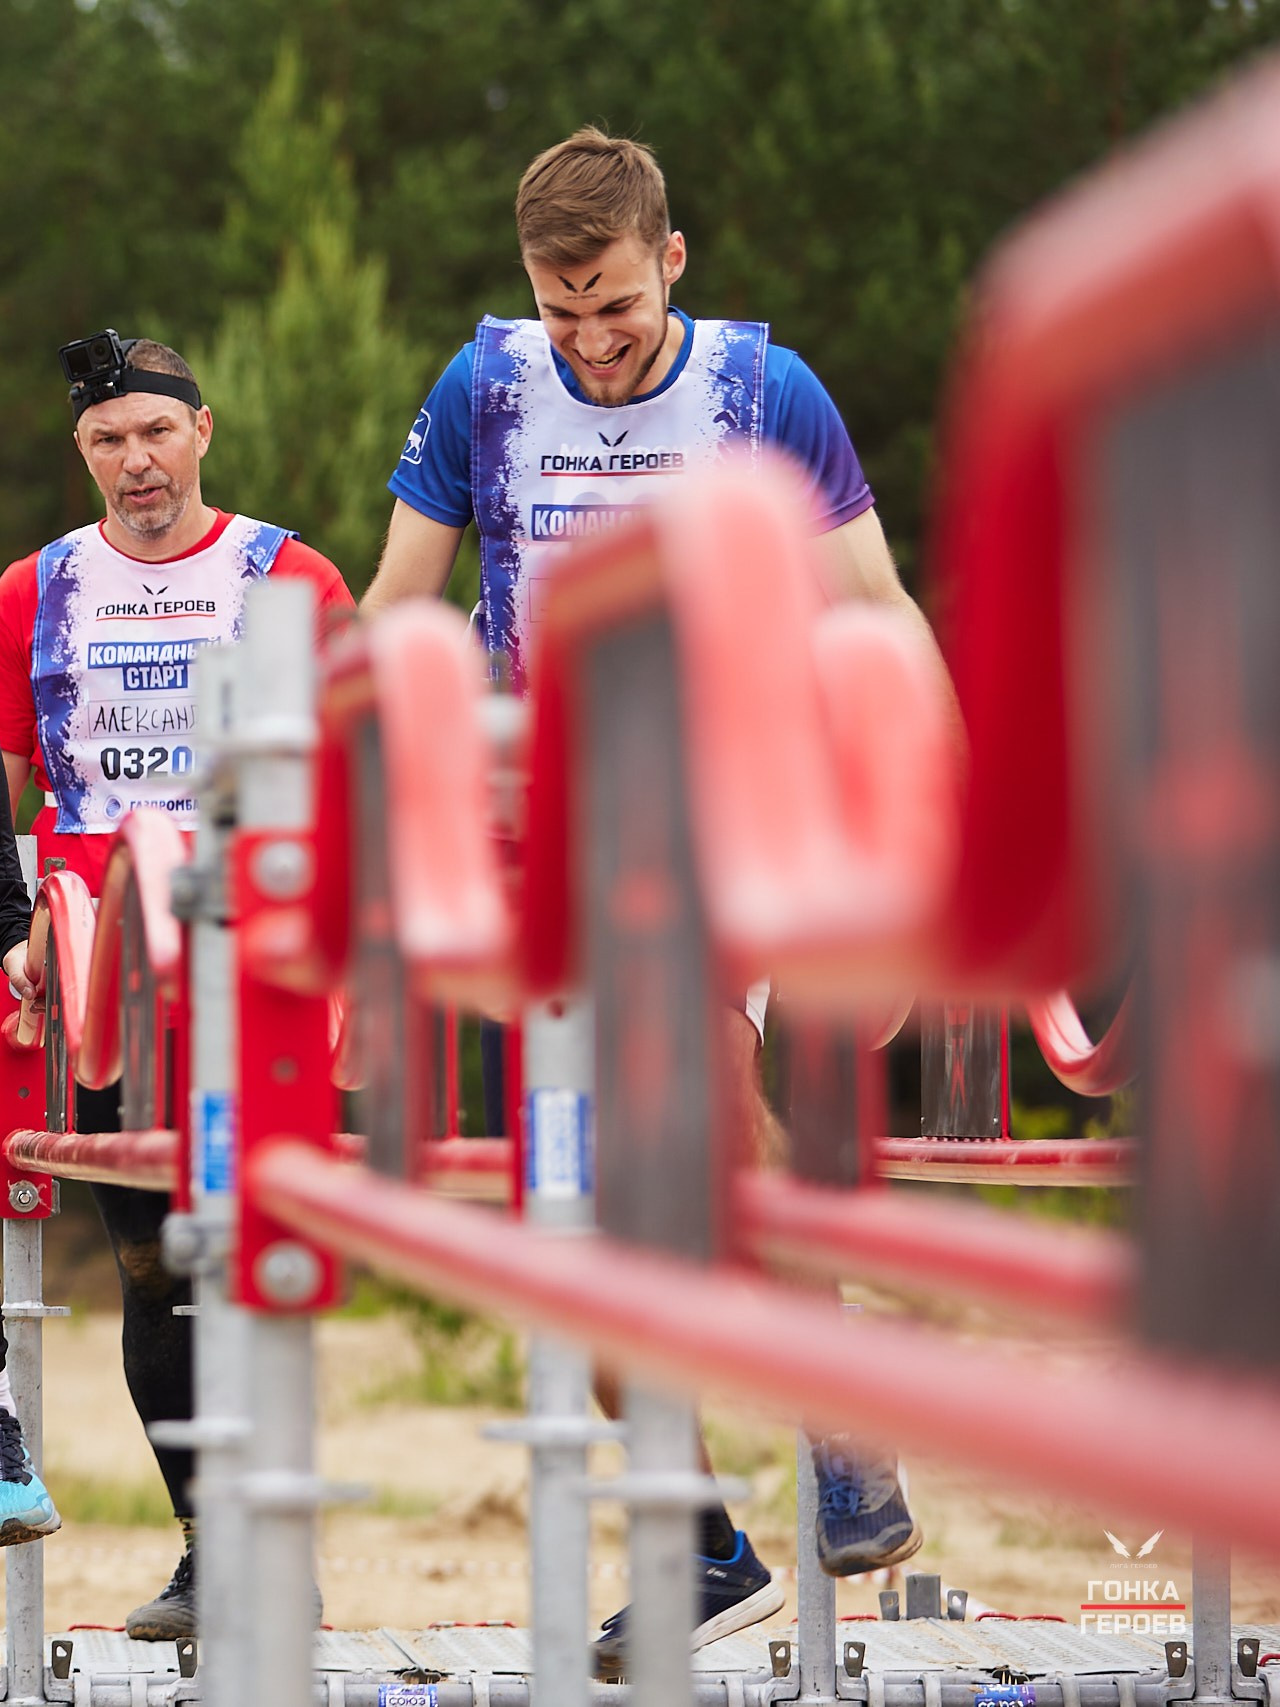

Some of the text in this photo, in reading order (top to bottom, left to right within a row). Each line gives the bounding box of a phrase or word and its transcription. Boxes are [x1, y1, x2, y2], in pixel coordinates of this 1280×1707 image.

[541, 453, 684, 471] ГОНКА ГЕРОЕВ
[96, 600, 216, 617] ГОНКА ГЕРОЕВ
[90, 638, 217, 666] КОМАНДНЫ
[126, 665, 184, 689] СТАРТ
[100, 746, 197, 780] 0320
